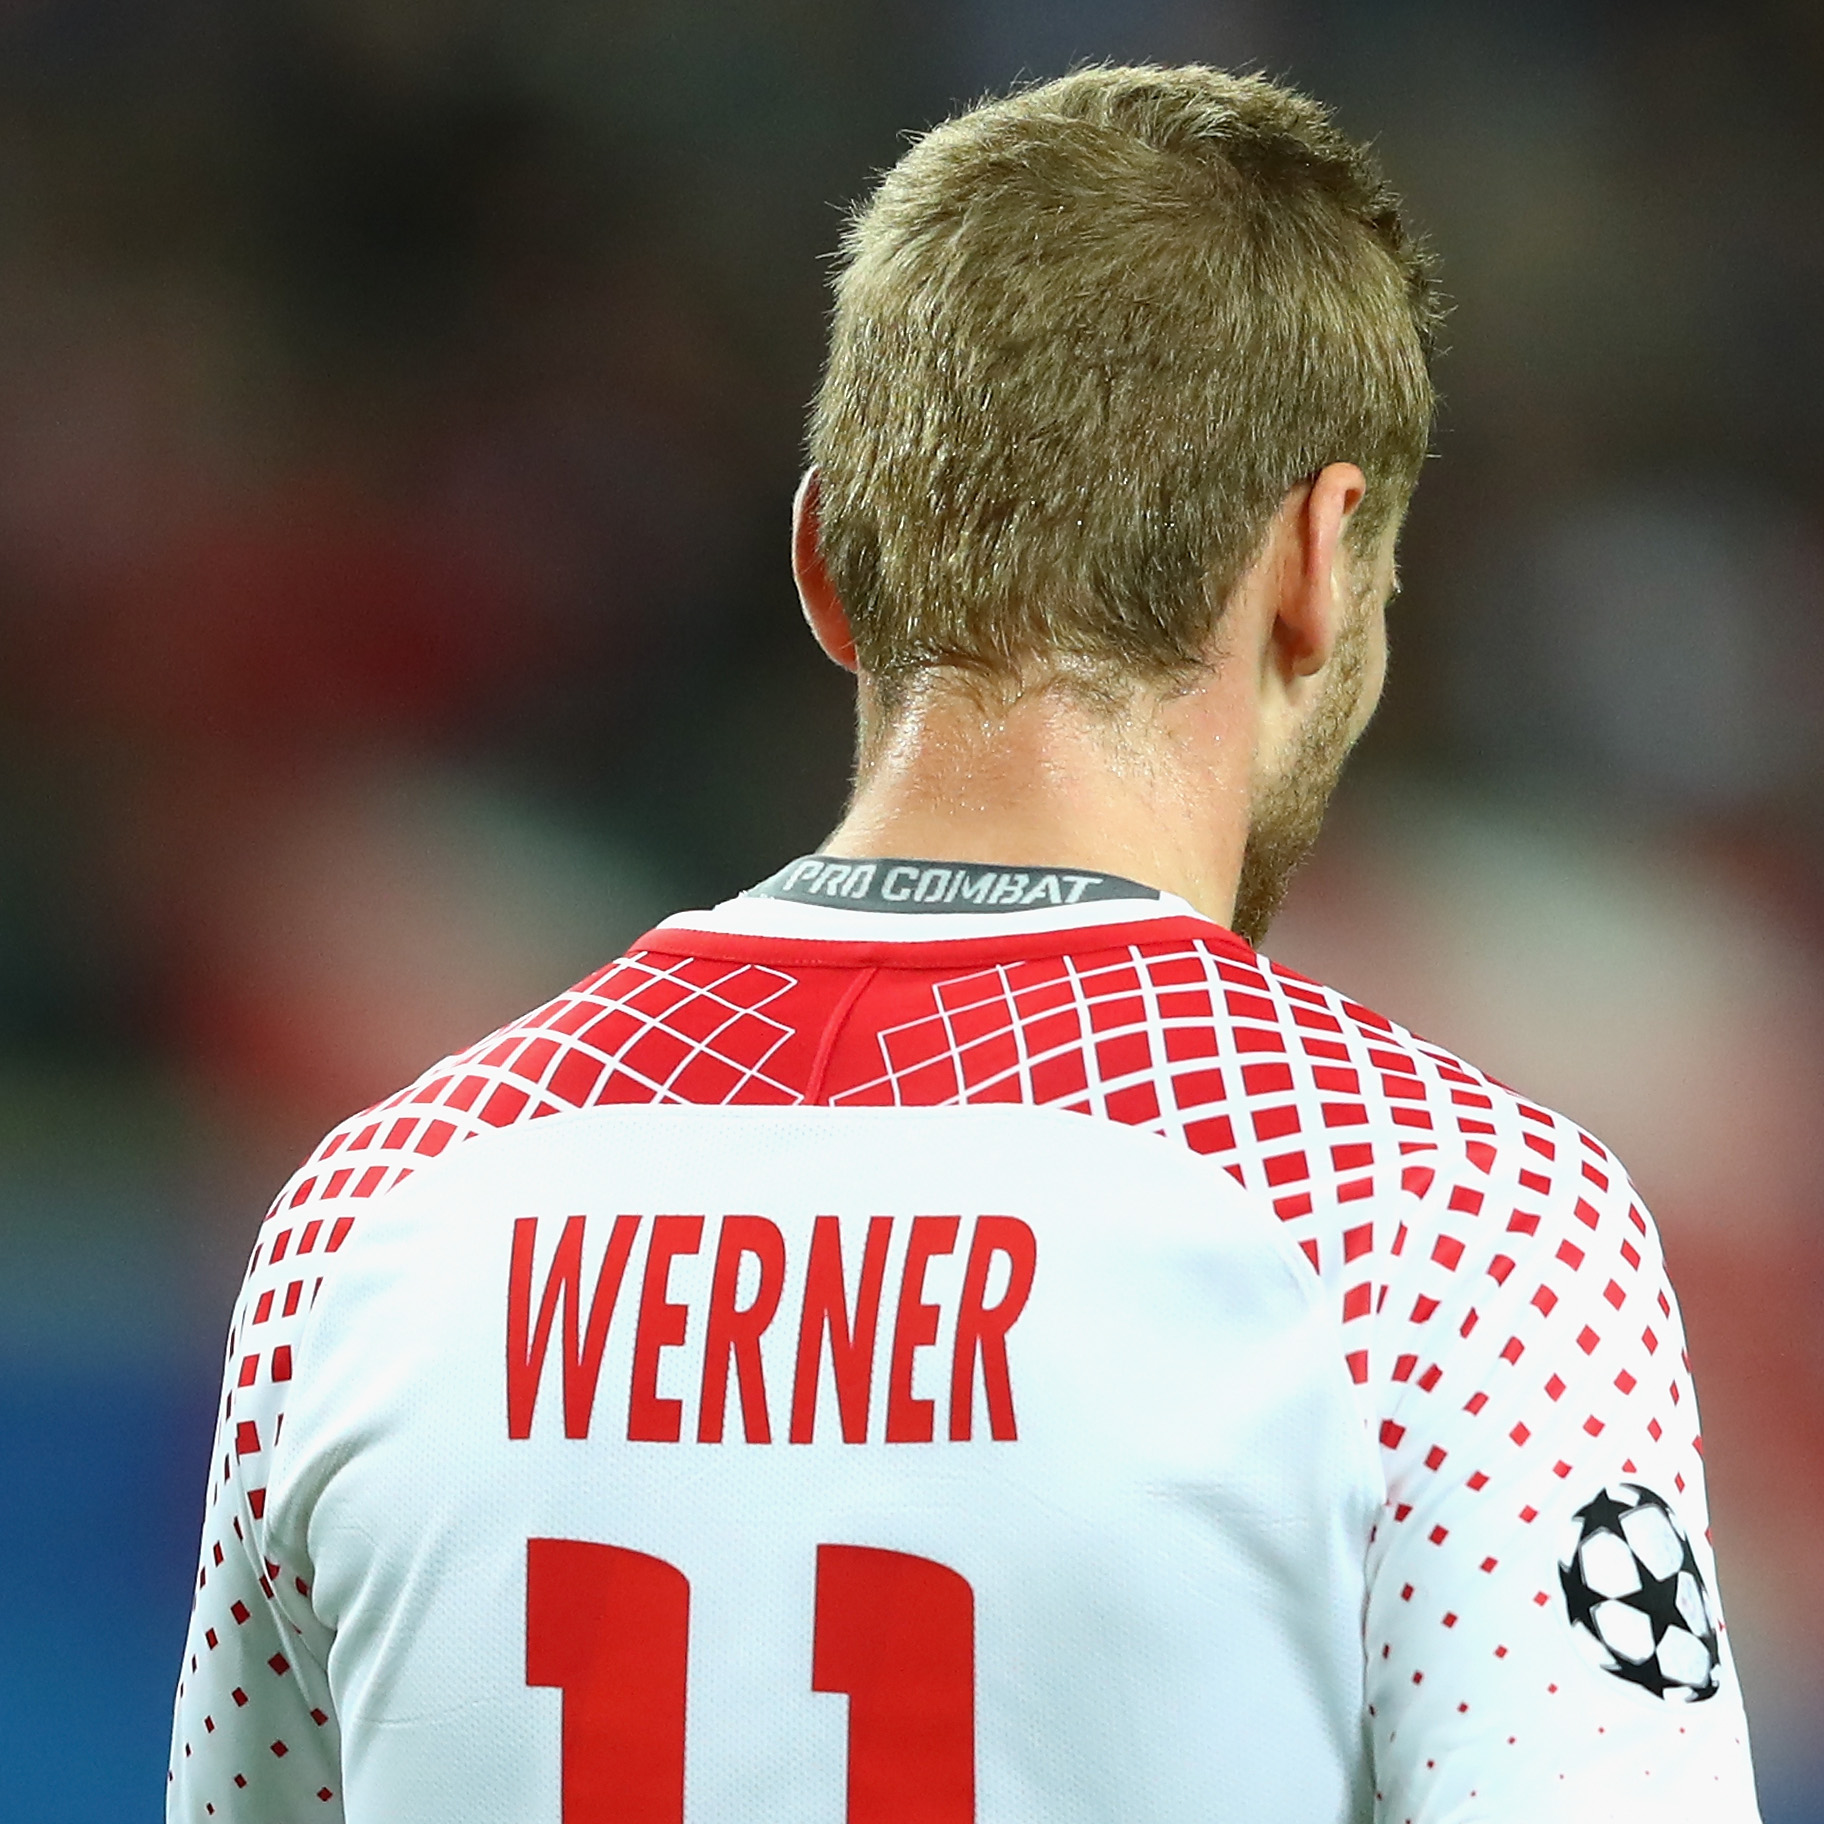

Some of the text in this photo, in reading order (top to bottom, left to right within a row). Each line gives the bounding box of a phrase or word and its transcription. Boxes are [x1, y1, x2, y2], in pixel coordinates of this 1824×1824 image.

[783, 861, 1103, 904] PRO COMBAT
[506, 1214, 1037, 1445] WERNER
